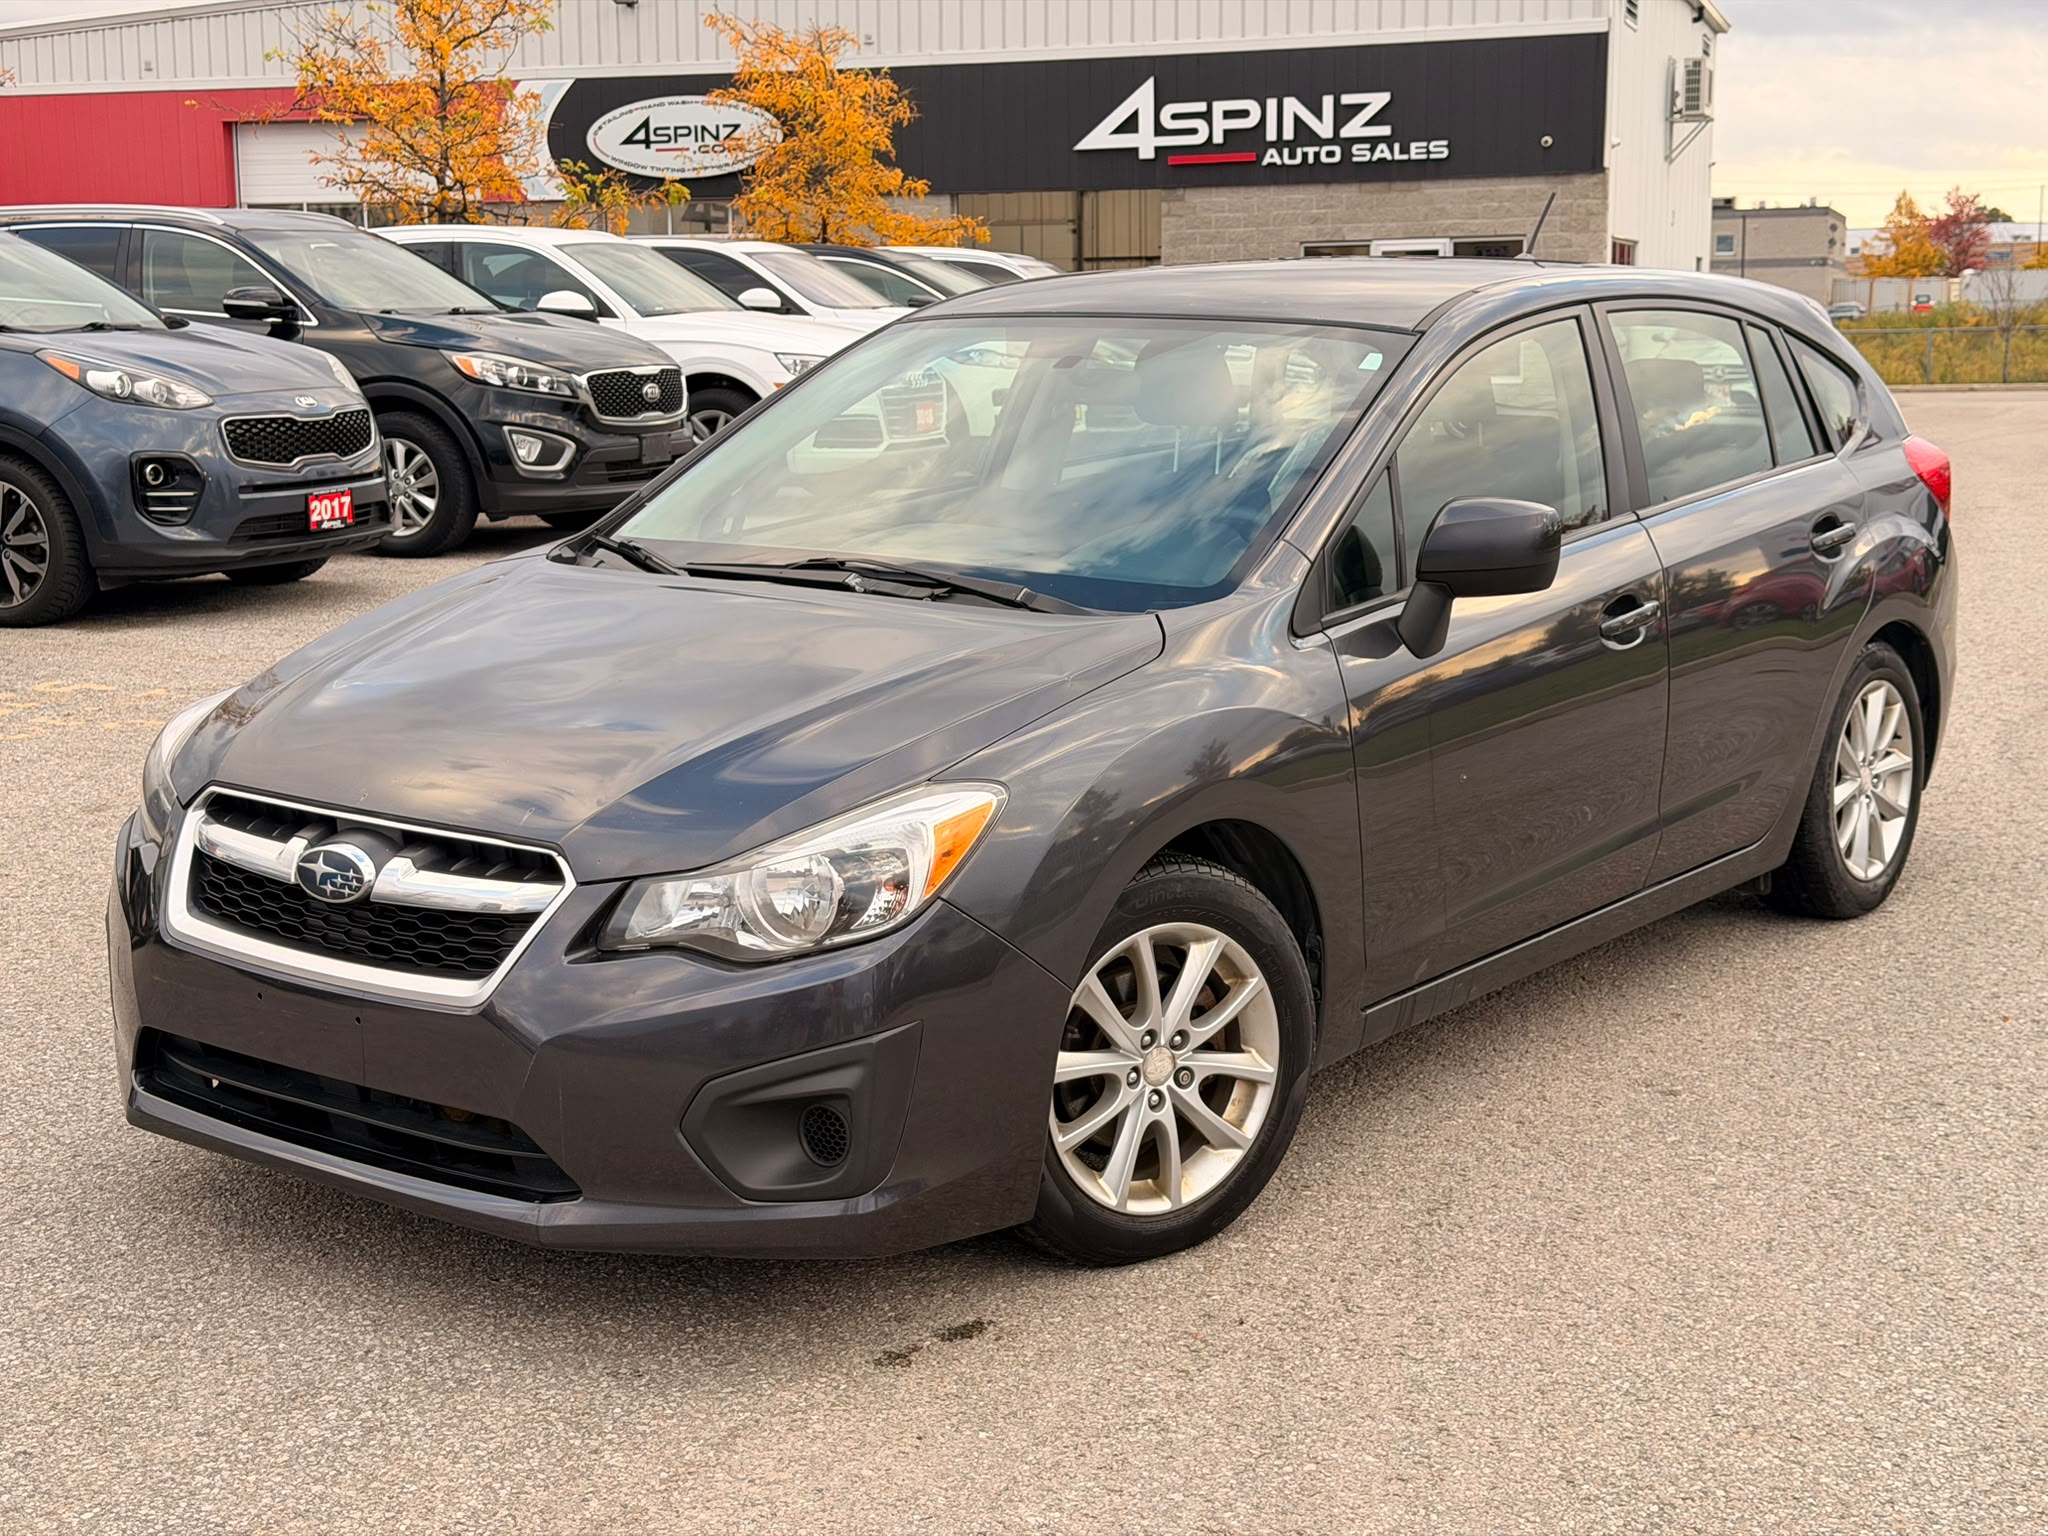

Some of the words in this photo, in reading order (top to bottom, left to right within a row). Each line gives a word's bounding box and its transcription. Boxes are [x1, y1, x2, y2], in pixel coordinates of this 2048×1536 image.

[641, 102, 666, 111] HAND
[1073, 75, 1393, 160] 4SPINZ
[619, 115, 742, 149] 4SPINZ
[692, 143, 731, 154] .CO
[1261, 145, 1342, 167] AUTO
[1350, 139, 1450, 163] SALES
[610, 156, 648, 170] WINDOW
[650, 165, 687, 173] TINTING
[310, 495, 351, 522] 2017
